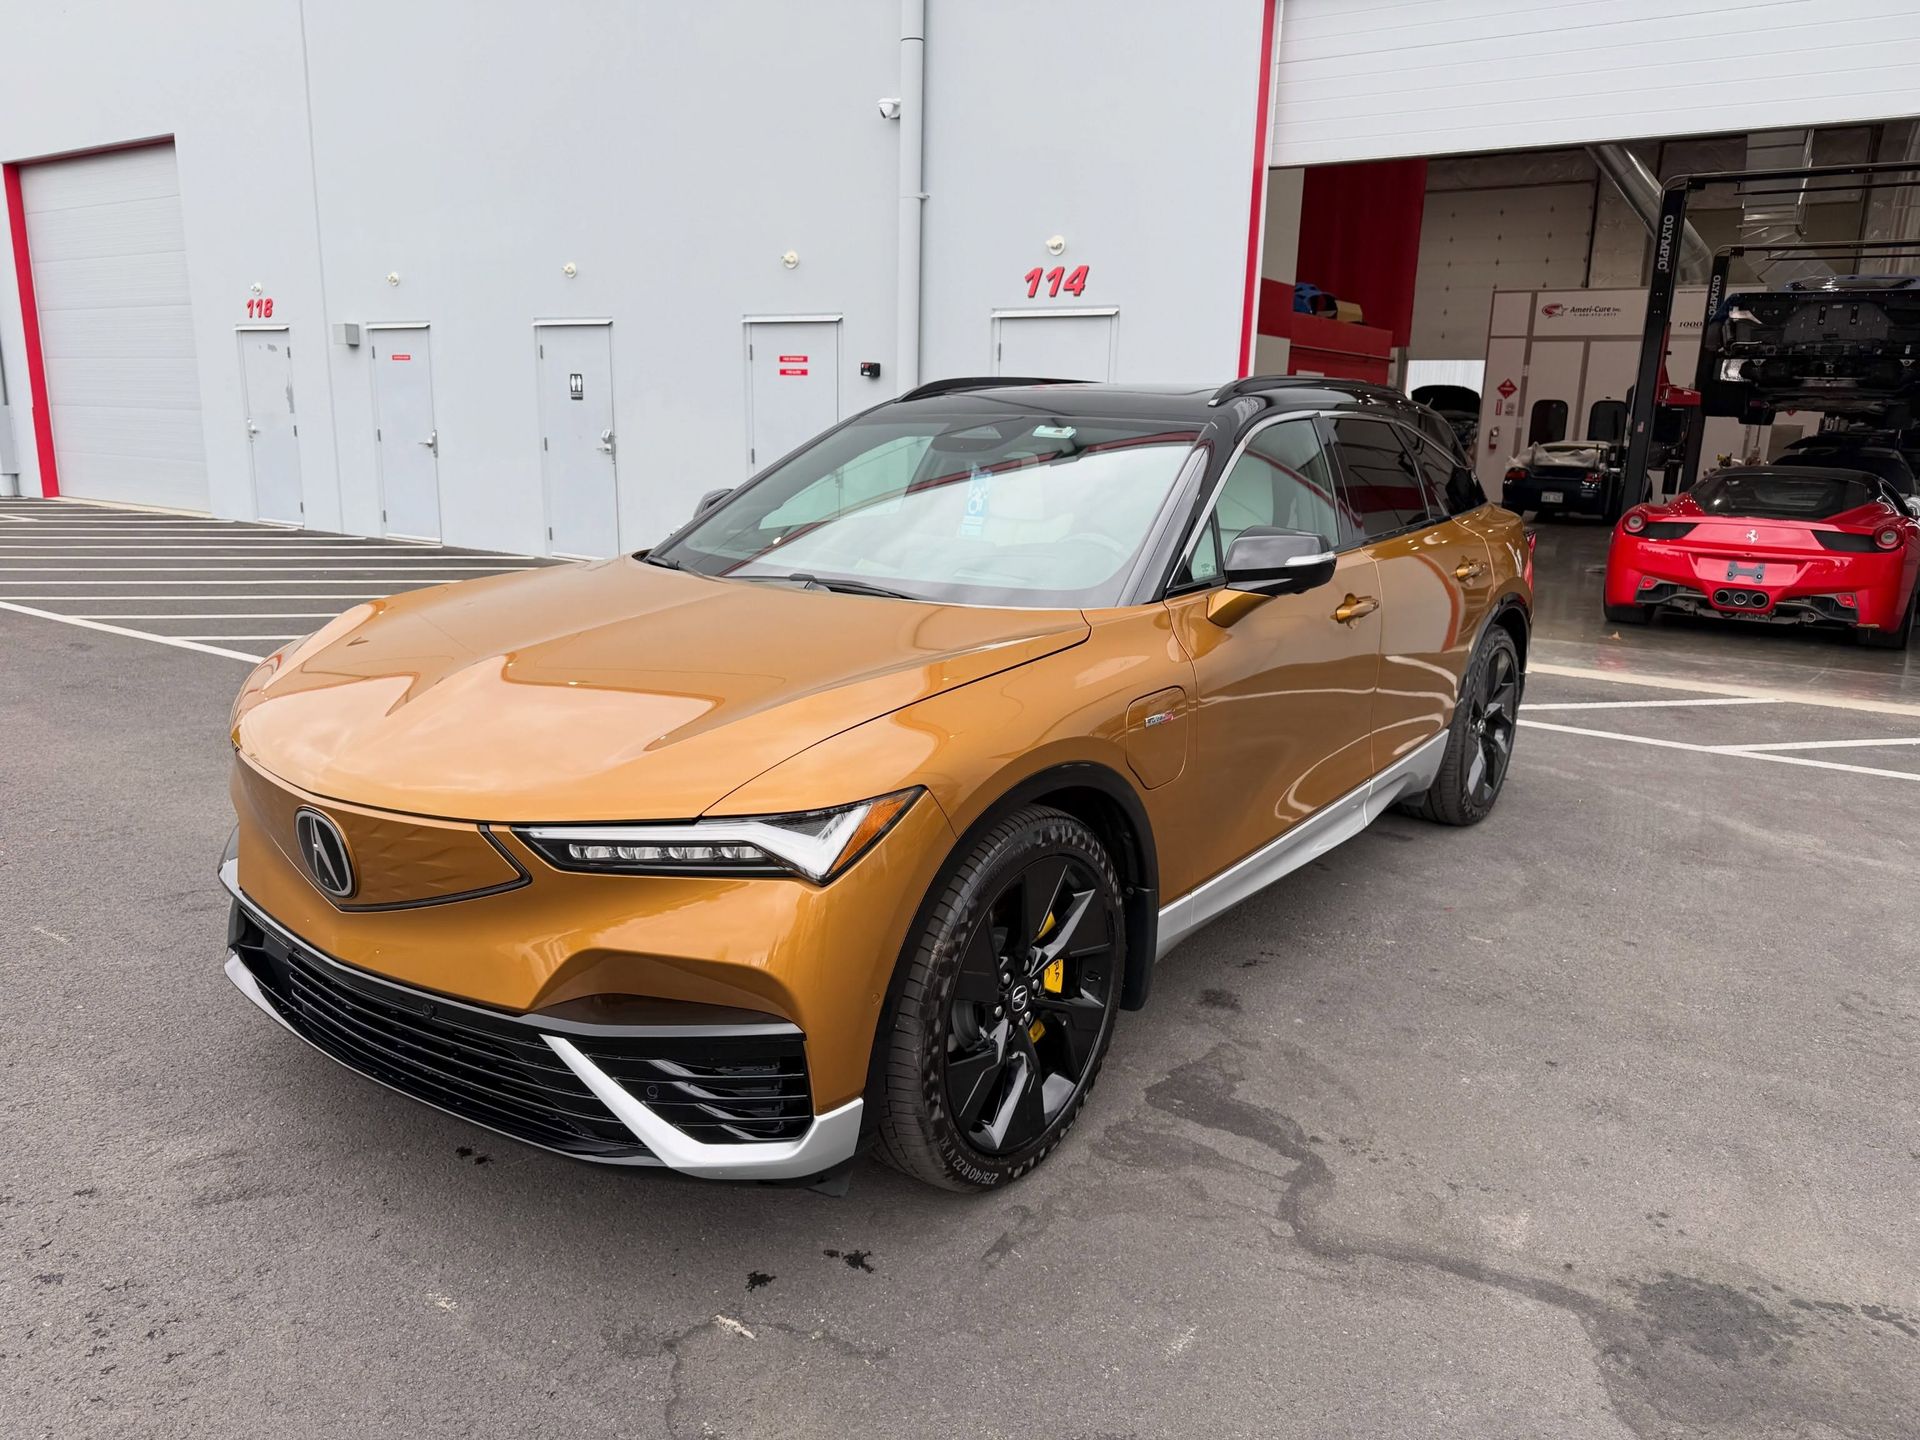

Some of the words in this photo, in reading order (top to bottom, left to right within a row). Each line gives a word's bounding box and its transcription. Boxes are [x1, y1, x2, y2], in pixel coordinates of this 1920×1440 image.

[1658, 215, 1674, 270] OLYMPIC
[1024, 265, 1089, 298] 114
[1708, 275, 1721, 316] OLYMPIC
[247, 298, 273, 318] 118
